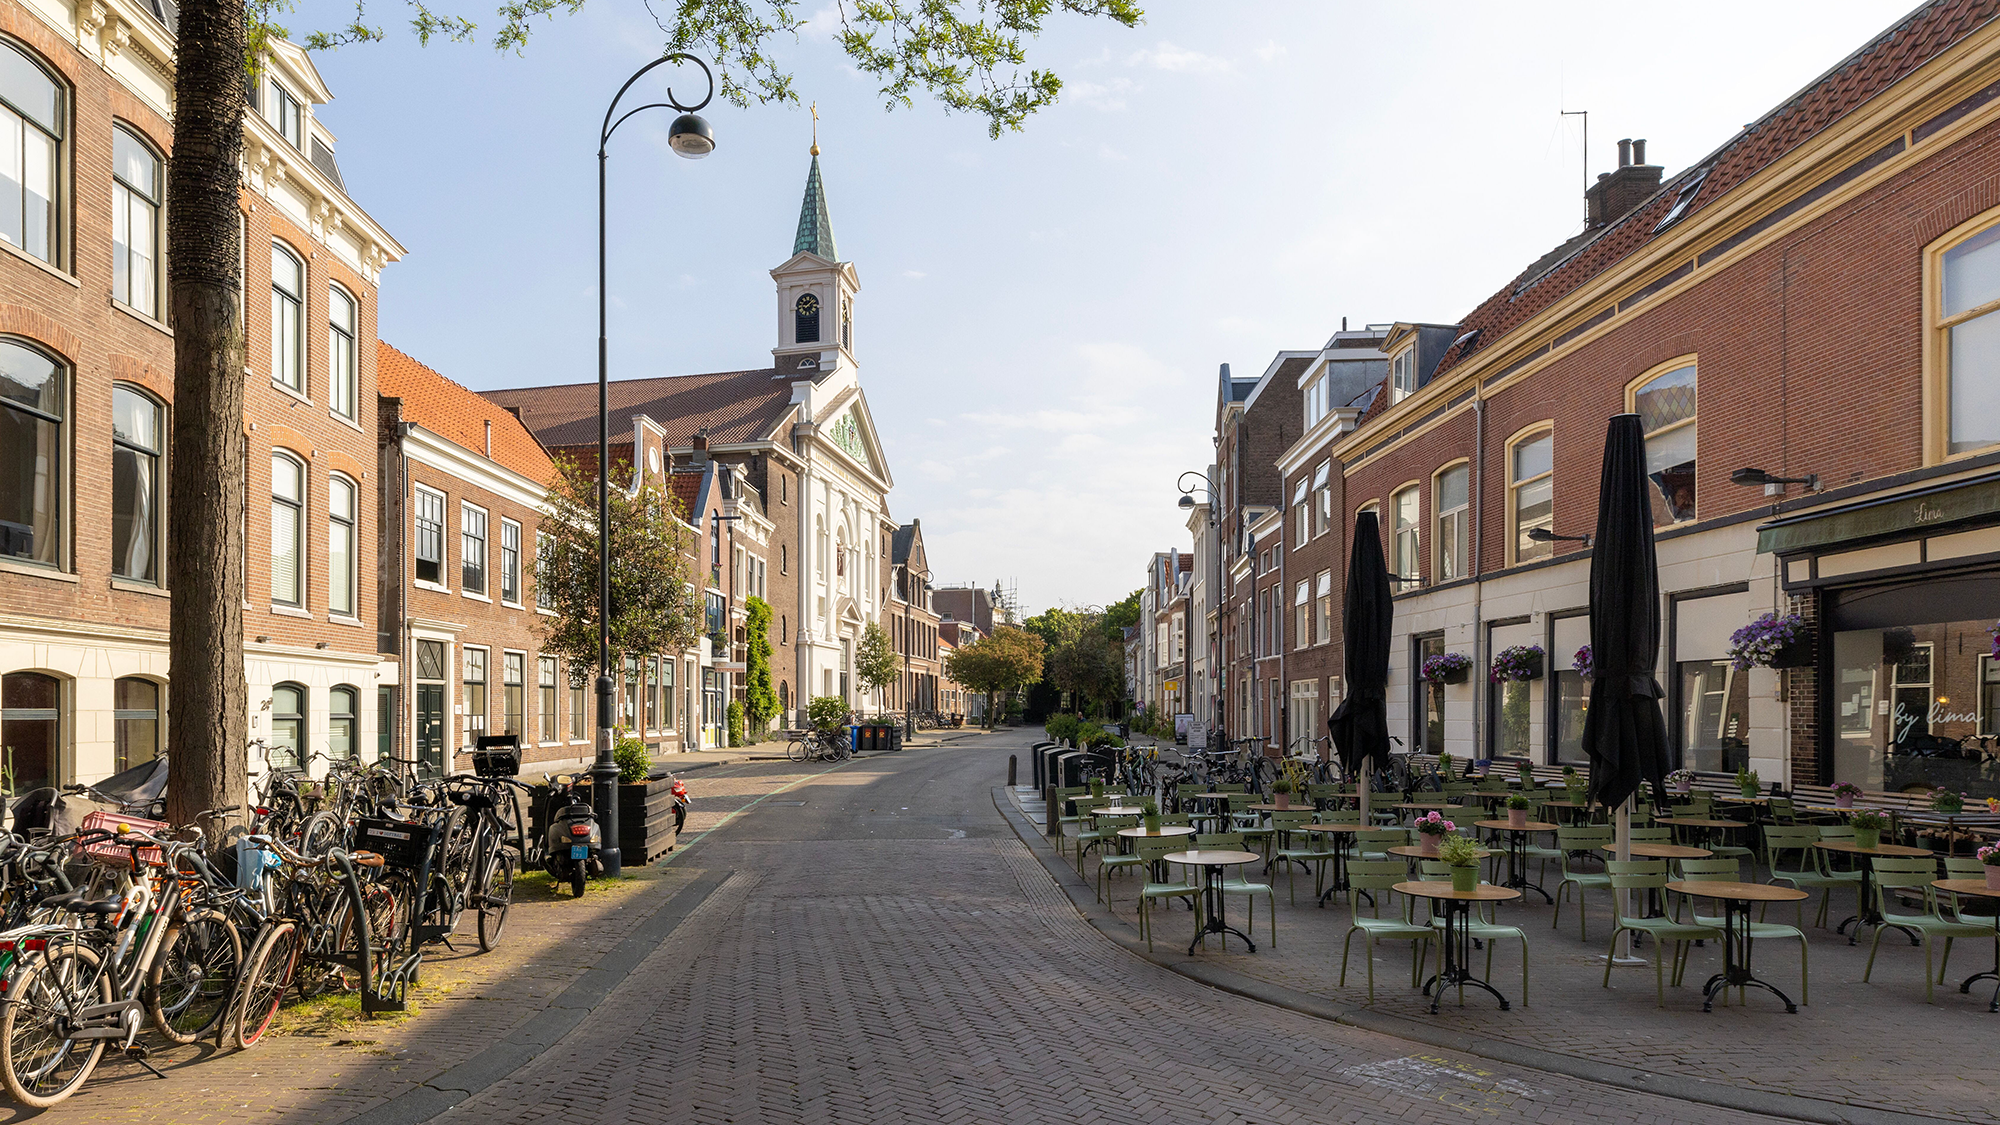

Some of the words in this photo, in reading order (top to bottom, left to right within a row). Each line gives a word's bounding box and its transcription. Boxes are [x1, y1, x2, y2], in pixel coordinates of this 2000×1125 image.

[1915, 503, 1944, 523] Lima
[1894, 703, 1919, 743] by
[1927, 702, 1984, 724] lima
